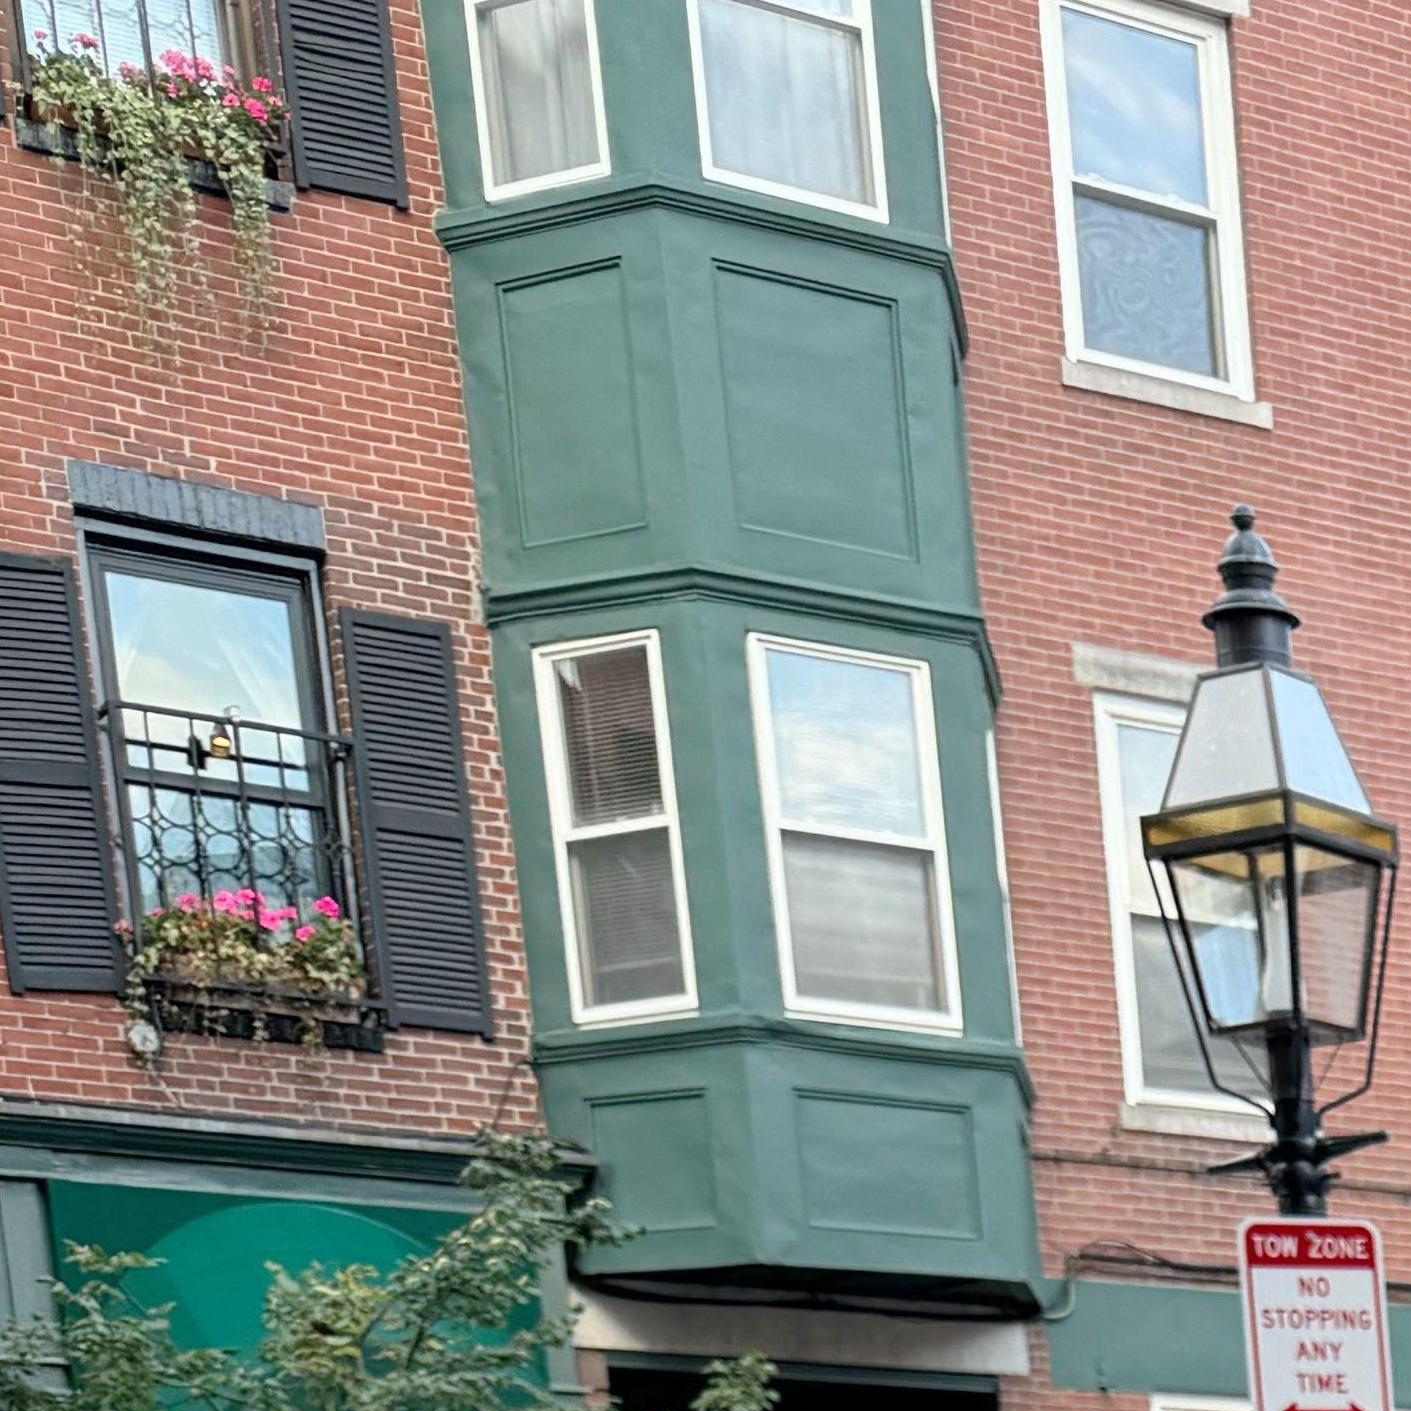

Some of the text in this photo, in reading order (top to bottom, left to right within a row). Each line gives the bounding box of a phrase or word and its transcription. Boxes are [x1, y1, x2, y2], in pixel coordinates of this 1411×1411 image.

[1252, 1235, 1370, 1260] TOW ZONE
[1298, 1276, 1331, 1298] NO
[1261, 1308, 1373, 1331] STOPPING
[1296, 1341, 1343, 1362] ANY
[1296, 1373, 1349, 1394] TIME
